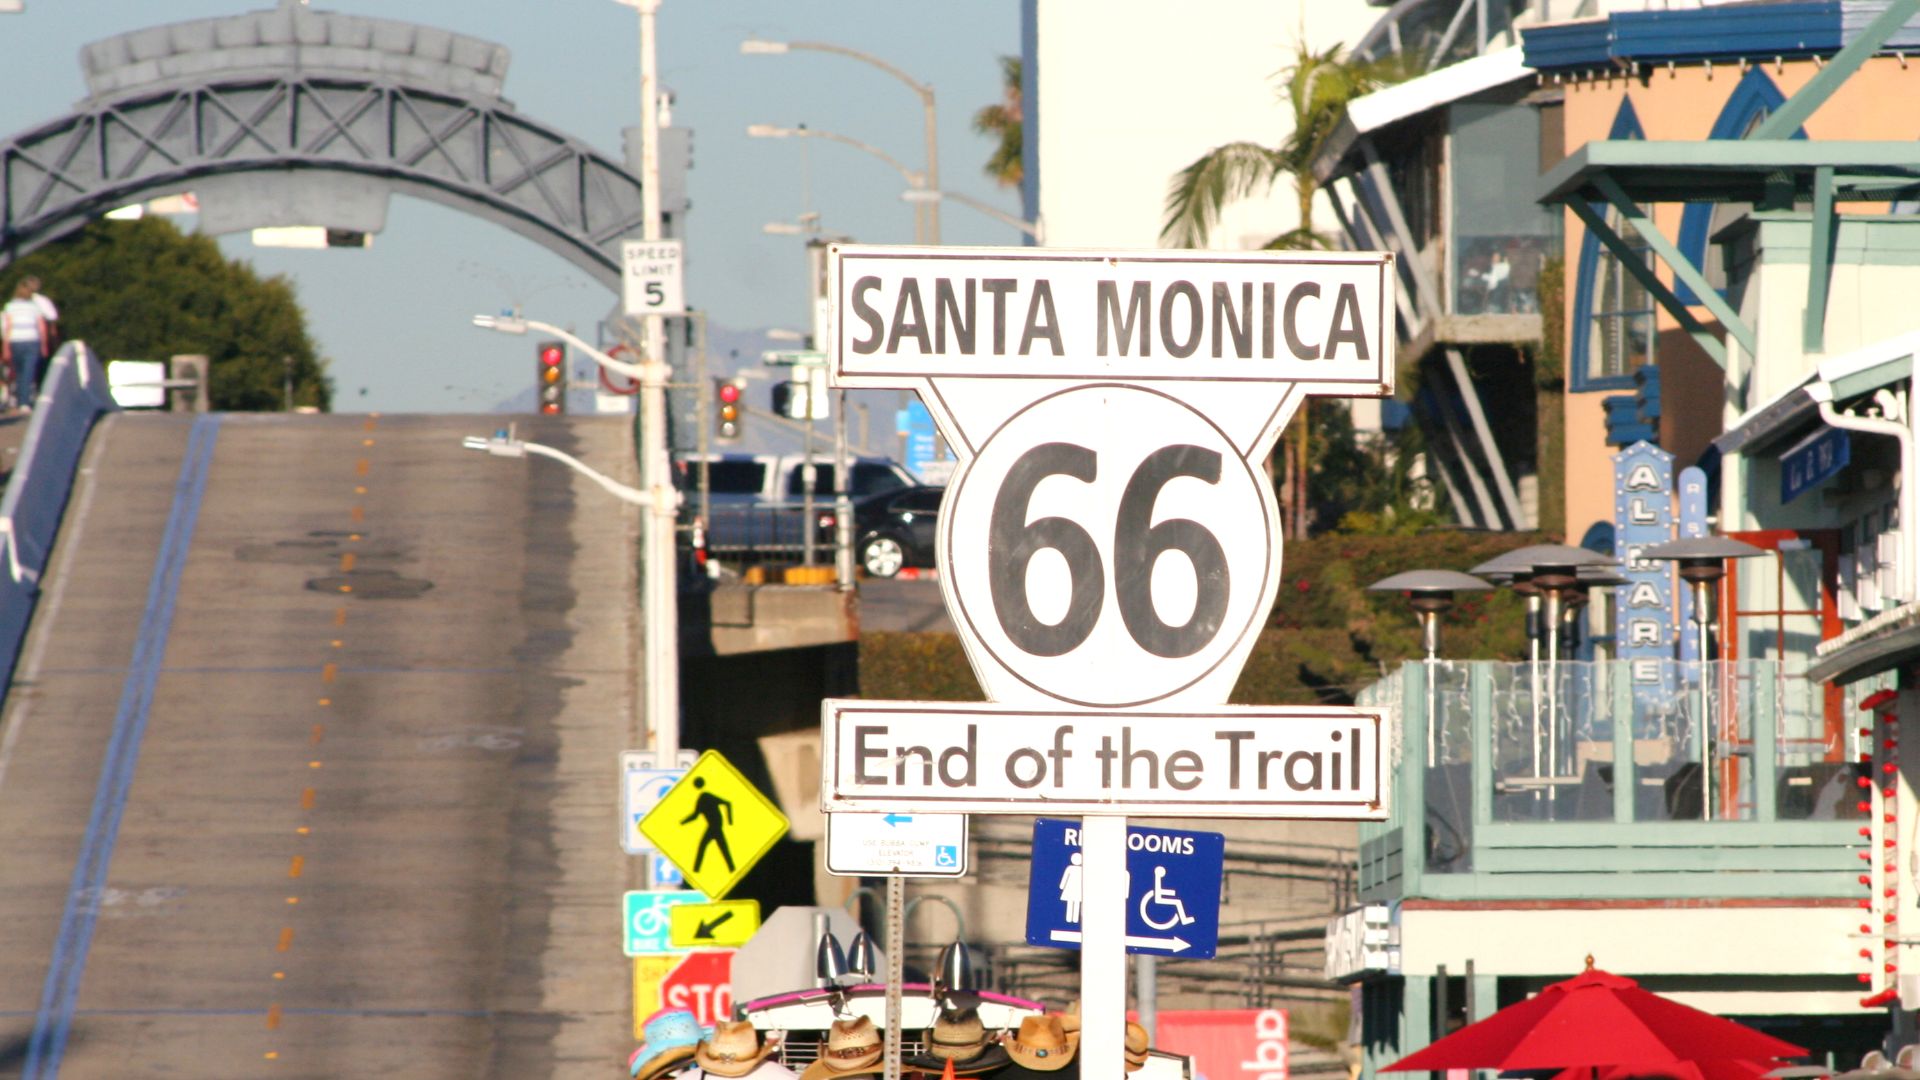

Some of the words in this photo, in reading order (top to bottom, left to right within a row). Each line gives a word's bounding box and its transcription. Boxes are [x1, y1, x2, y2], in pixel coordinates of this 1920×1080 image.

[626, 247, 677, 260] SPEED
[631, 263, 674, 277] LIMIT
[645, 281, 665, 307] 5
[851, 274, 1066, 357] SANTA
[1096, 279, 1371, 362] MONICA
[988, 441, 1231, 659] 66
[853, 723, 978, 788] End
[1004, 724, 1074, 789] of
[1096, 726, 1204, 791] the
[1214, 728, 1361, 792] Trail
[1064, 827, 1195, 856] ROOMS
[668, 984, 732, 1025] STO
